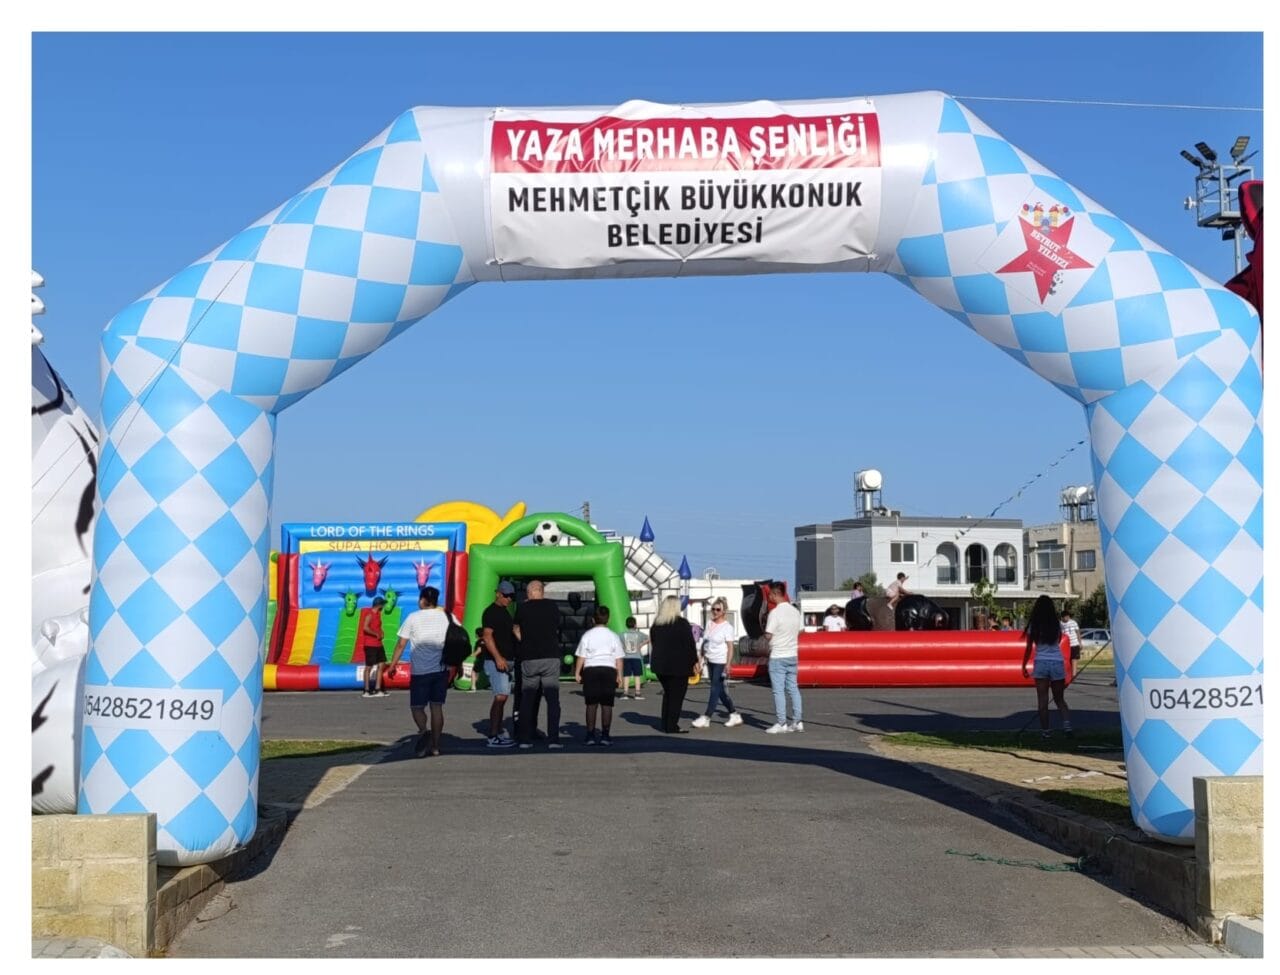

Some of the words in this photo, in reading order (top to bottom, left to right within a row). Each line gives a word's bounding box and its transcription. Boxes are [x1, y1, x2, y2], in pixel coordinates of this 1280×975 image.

[506, 128, 584, 162] YAZA
[593, 126, 742, 161] MERHABA
[749, 115, 868, 165] ŞENLİĞİ
[508, 180, 671, 218] MEHMETÇİK
[681, 178, 862, 210] BÜYÜKKONUK
[607, 216, 763, 248] BELEDİYESİ
[310, 526, 344, 537] LORD
[348, 526, 366, 537] OF
[369, 526, 393, 537] THE
[396, 525, 435, 536] RINGS
[328, 541, 361, 552] SUPA
[368, 540, 422, 551] HOOPLA
[1149, 684, 1264, 709] 05428521
